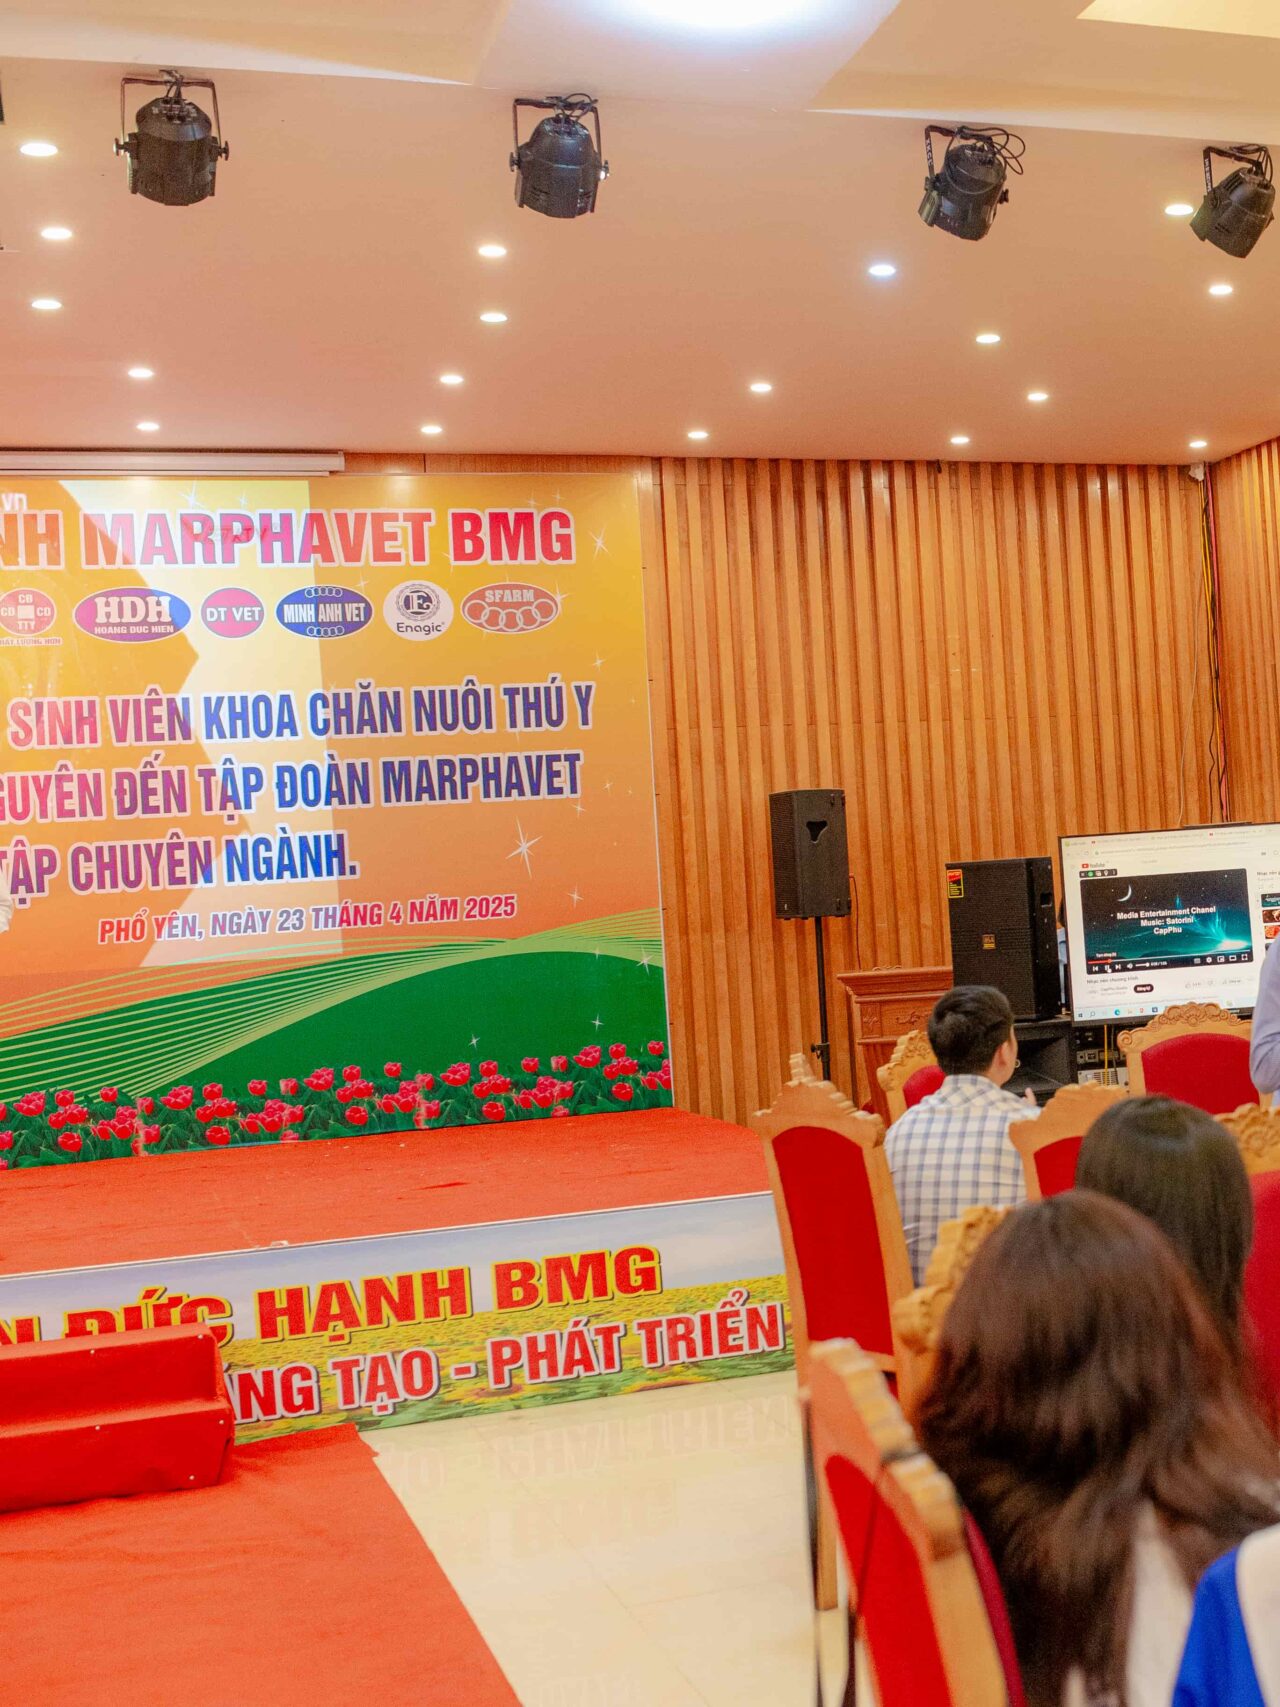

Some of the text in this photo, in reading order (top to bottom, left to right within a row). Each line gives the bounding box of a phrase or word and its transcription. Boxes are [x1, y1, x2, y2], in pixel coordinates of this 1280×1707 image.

[82, 511, 433, 566] MARPHAVET
[450, 510, 574, 562] BMG
[484, 589, 536, 603] SFARM
[94, 596, 172, 624] HDH
[206, 606, 262, 622] DT VET
[283, 602, 366, 624] MINH ANH VET
[94, 624, 174, 635] HOANG DUC HIEN
[396, 621, 443, 636] Enagic
[9, 676, 594, 748] SINH VIÊN KHOA CHĂN NUÔI THÚ Y
[0, 752, 582, 822] UYÊN ĐẾN TẬP ĐOÀN MARPHAVET
[71, 831, 214, 892] CHUYÊN
[225, 826, 358, 884] NGÀNH.
[99, 894, 518, 943] PHỔ YÊN, NGÀY 23 THÁNG 4 NĂM 2025
[1116, 905, 1217, 920] Media Entertainment Chanel
[1140, 916, 1195, 927] Music: Satorini
[1153, 926, 1183, 936] CapPhu
[256, 1268, 468, 1343] HẠNH
[493, 1246, 658, 1311] BMG
[225, 1362, 317, 1421] NG
[331, 1349, 437, 1412] TẠO
[489, 1318, 621, 1387] PHÁT
[636, 1289, 784, 1369] TRIỂN
